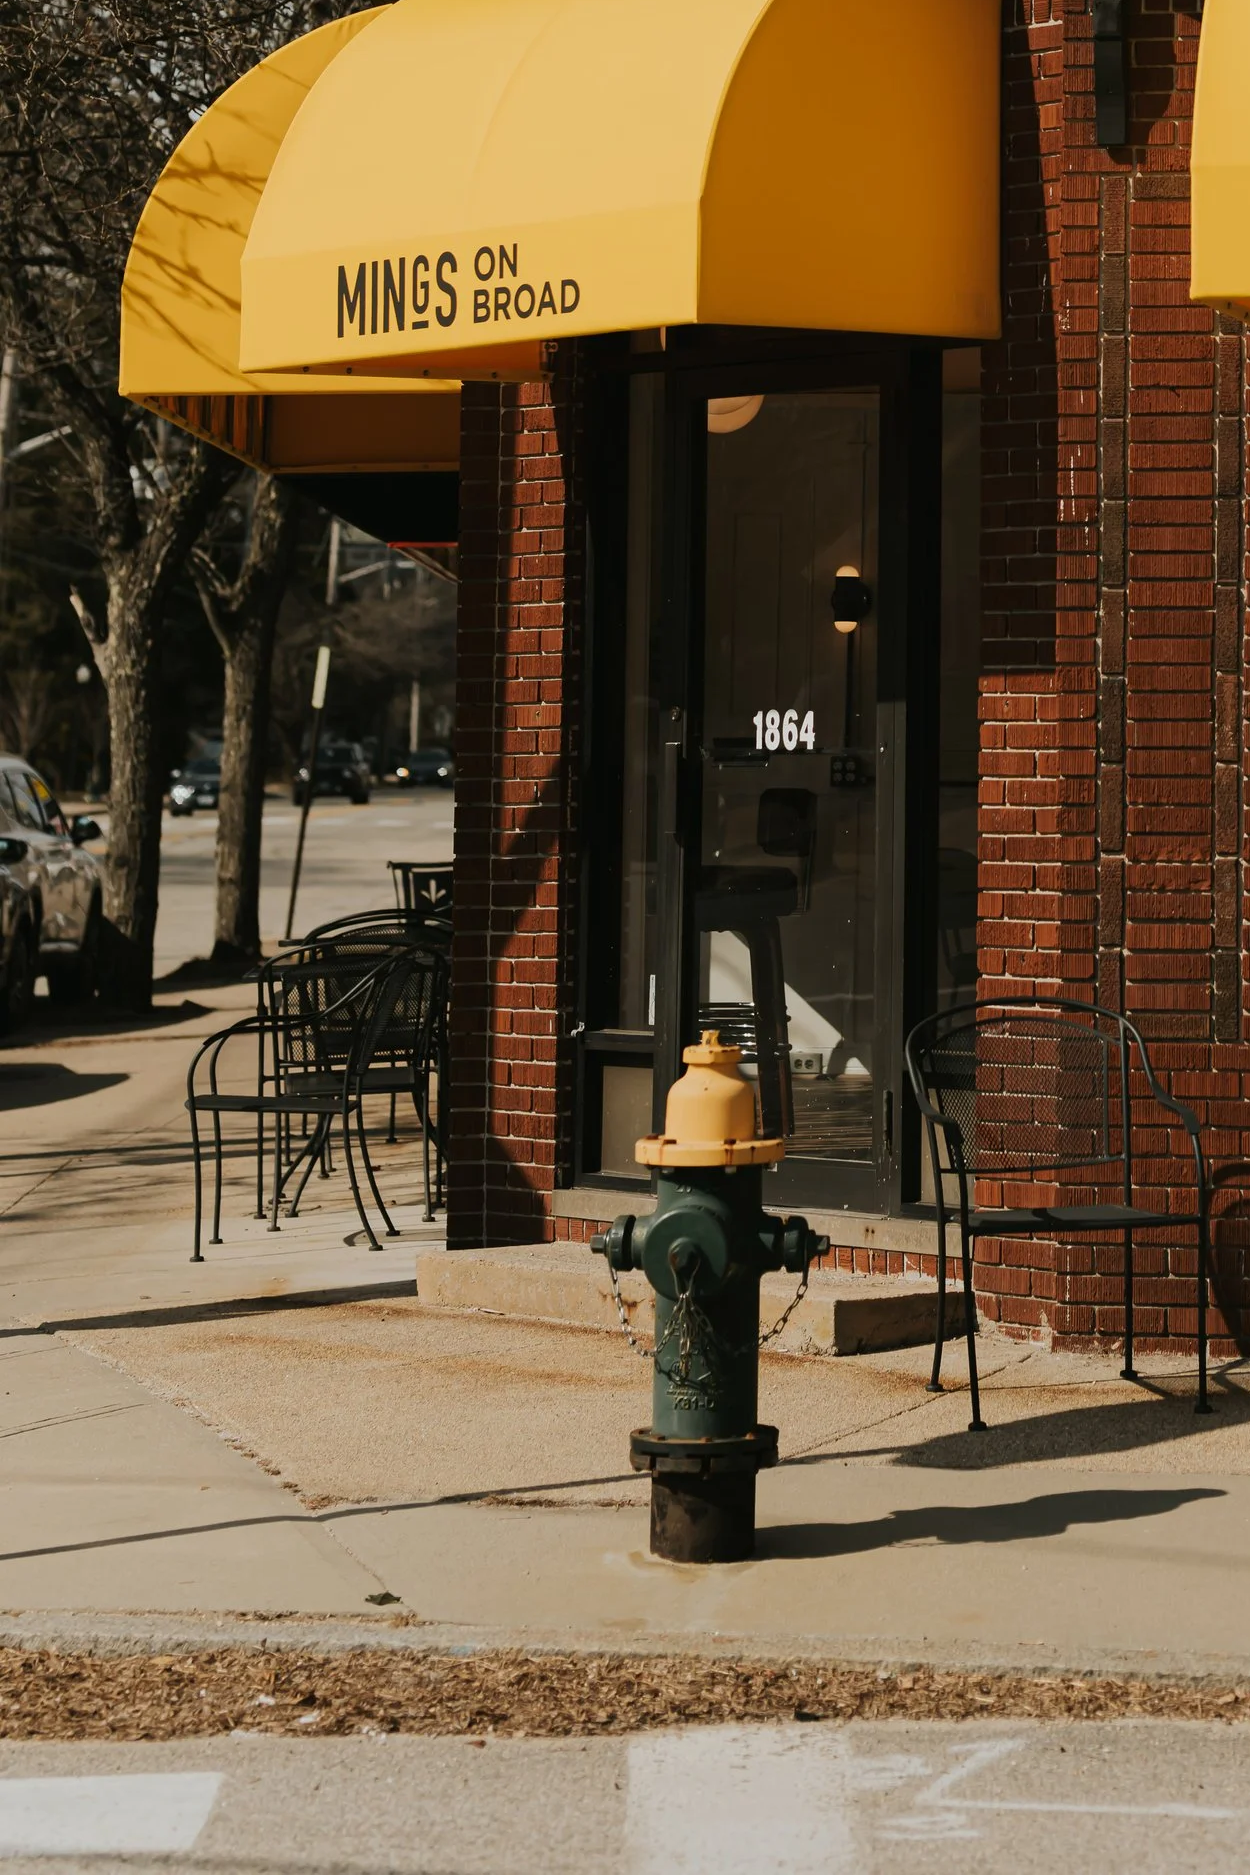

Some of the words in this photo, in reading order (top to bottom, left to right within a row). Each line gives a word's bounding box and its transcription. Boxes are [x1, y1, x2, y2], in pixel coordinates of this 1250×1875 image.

[473, 243, 518, 281] ON
[337, 251, 458, 338] MINGS
[473, 278, 581, 324] BROAD
[753, 709, 816, 751] 1864
